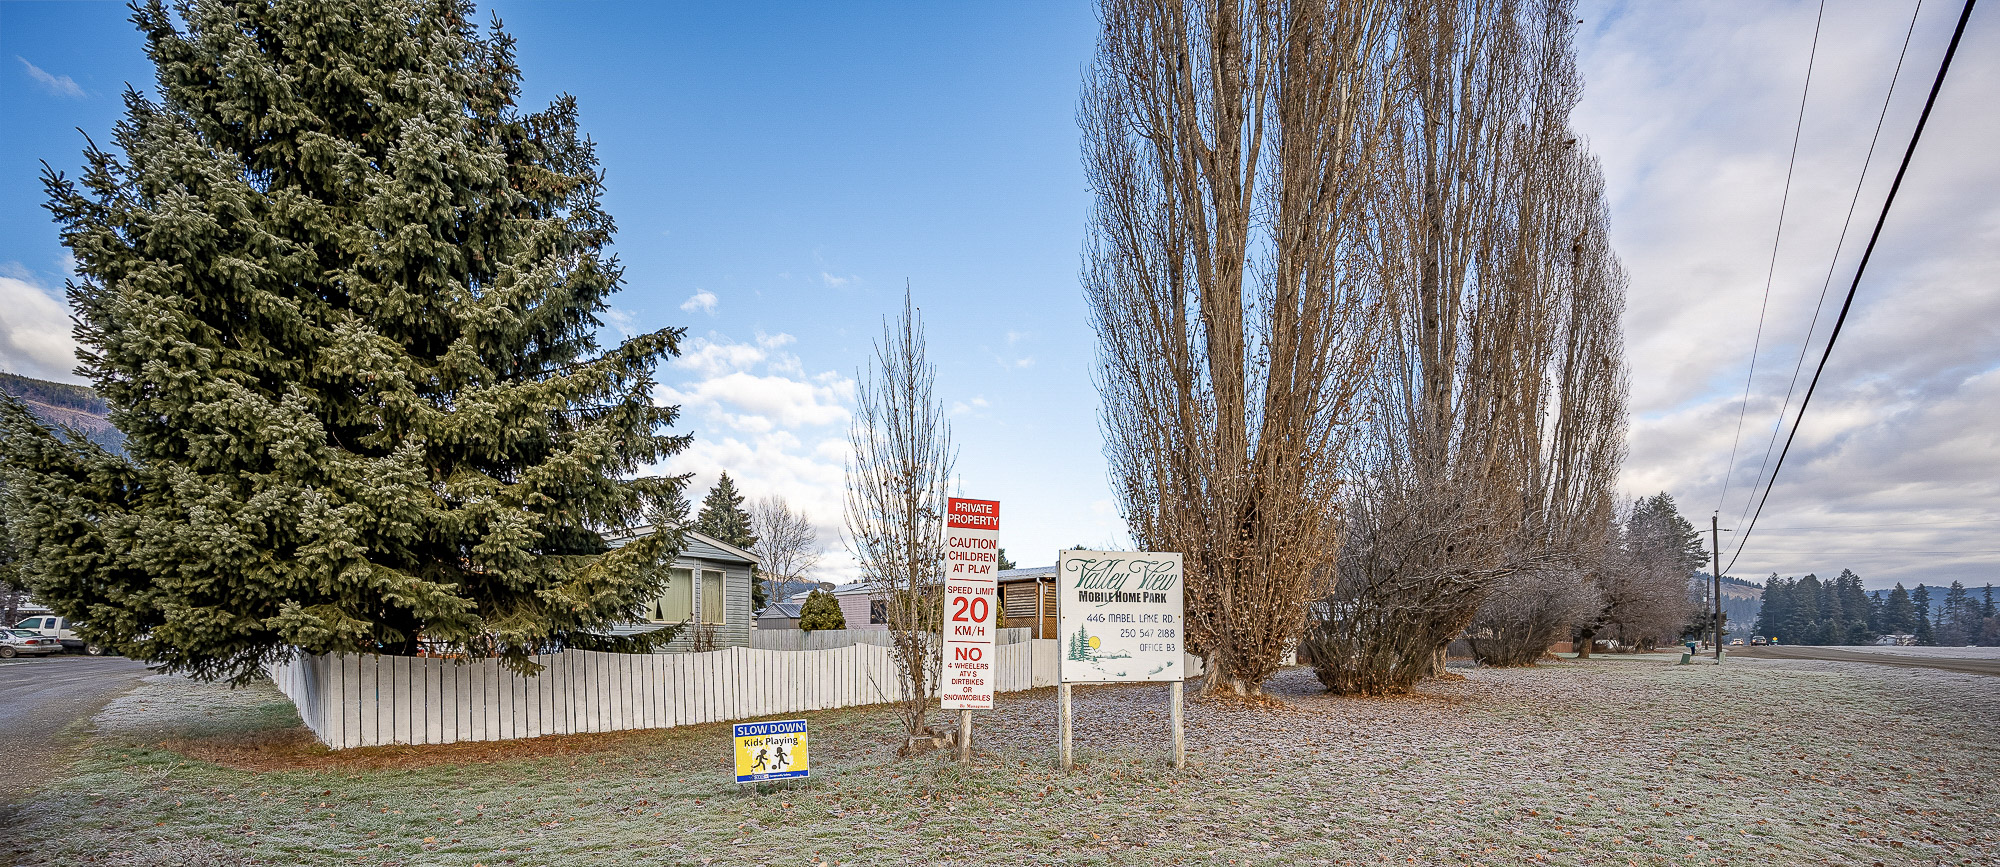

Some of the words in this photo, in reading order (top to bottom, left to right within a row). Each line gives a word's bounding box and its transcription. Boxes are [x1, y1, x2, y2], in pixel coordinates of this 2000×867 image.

[955, 502, 992, 514] PRIVATE
[948, 513, 998, 526] PROPERTY
[949, 537, 996, 549] CAUTION
[948, 551, 996, 562] CHILDREN
[953, 564, 964, 573] AT
[968, 564, 990, 574] PLAY
[1066, 559, 1130, 607] Valley
[1128, 560, 1177, 590] View
[947, 586, 972, 594] SPEED
[1079, 590, 1113, 602] MOBILE
[1116, 591, 1141, 603] HOME
[1143, 592, 1167, 603] PARK
[952, 596, 988, 623] 20
[1086, 614, 1104, 623] 446
[1108, 614, 1135, 623] MABEL
[1139, 614, 1158, 623] LAKE
[955, 626, 985, 636] KM/H
[1120, 629, 1136, 638] 250
[1140, 629, 1154, 638] 547
[1157, 629, 1175, 638] 2188
[1140, 643, 1163, 652] OFFICE
[955, 647, 982, 661] NO
[737, 724, 767, 735] SLOW
[744, 738, 763, 747] Kids
[766, 736, 798, 747] Playing
